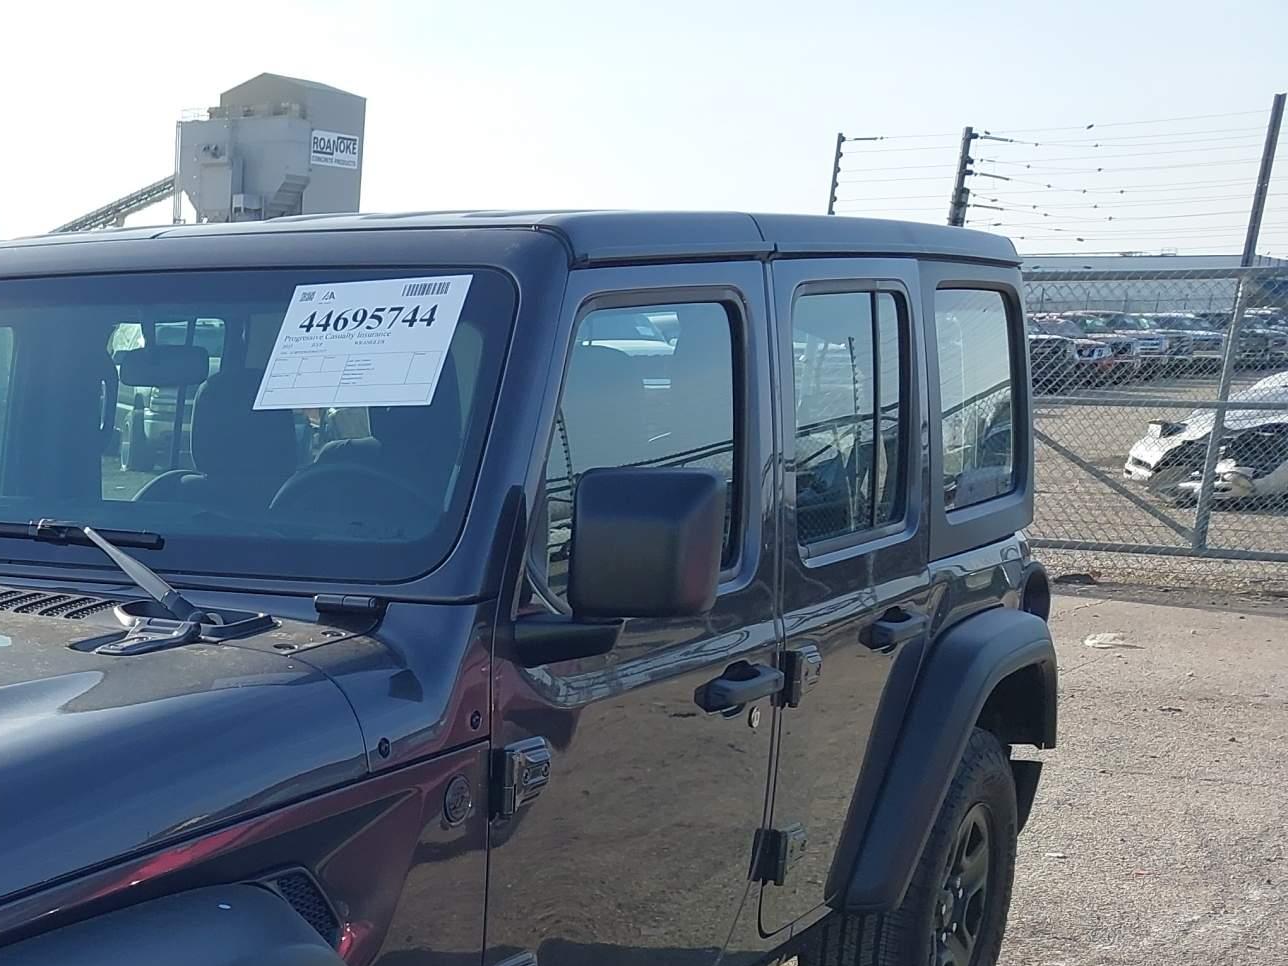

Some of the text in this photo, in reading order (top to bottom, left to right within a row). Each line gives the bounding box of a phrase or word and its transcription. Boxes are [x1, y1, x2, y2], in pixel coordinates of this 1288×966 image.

[312, 136, 357, 155] ROANOKE
[299, 303, 438, 333] 44695744
[284, 331, 392, 343] Progressive Casualty Insurance
